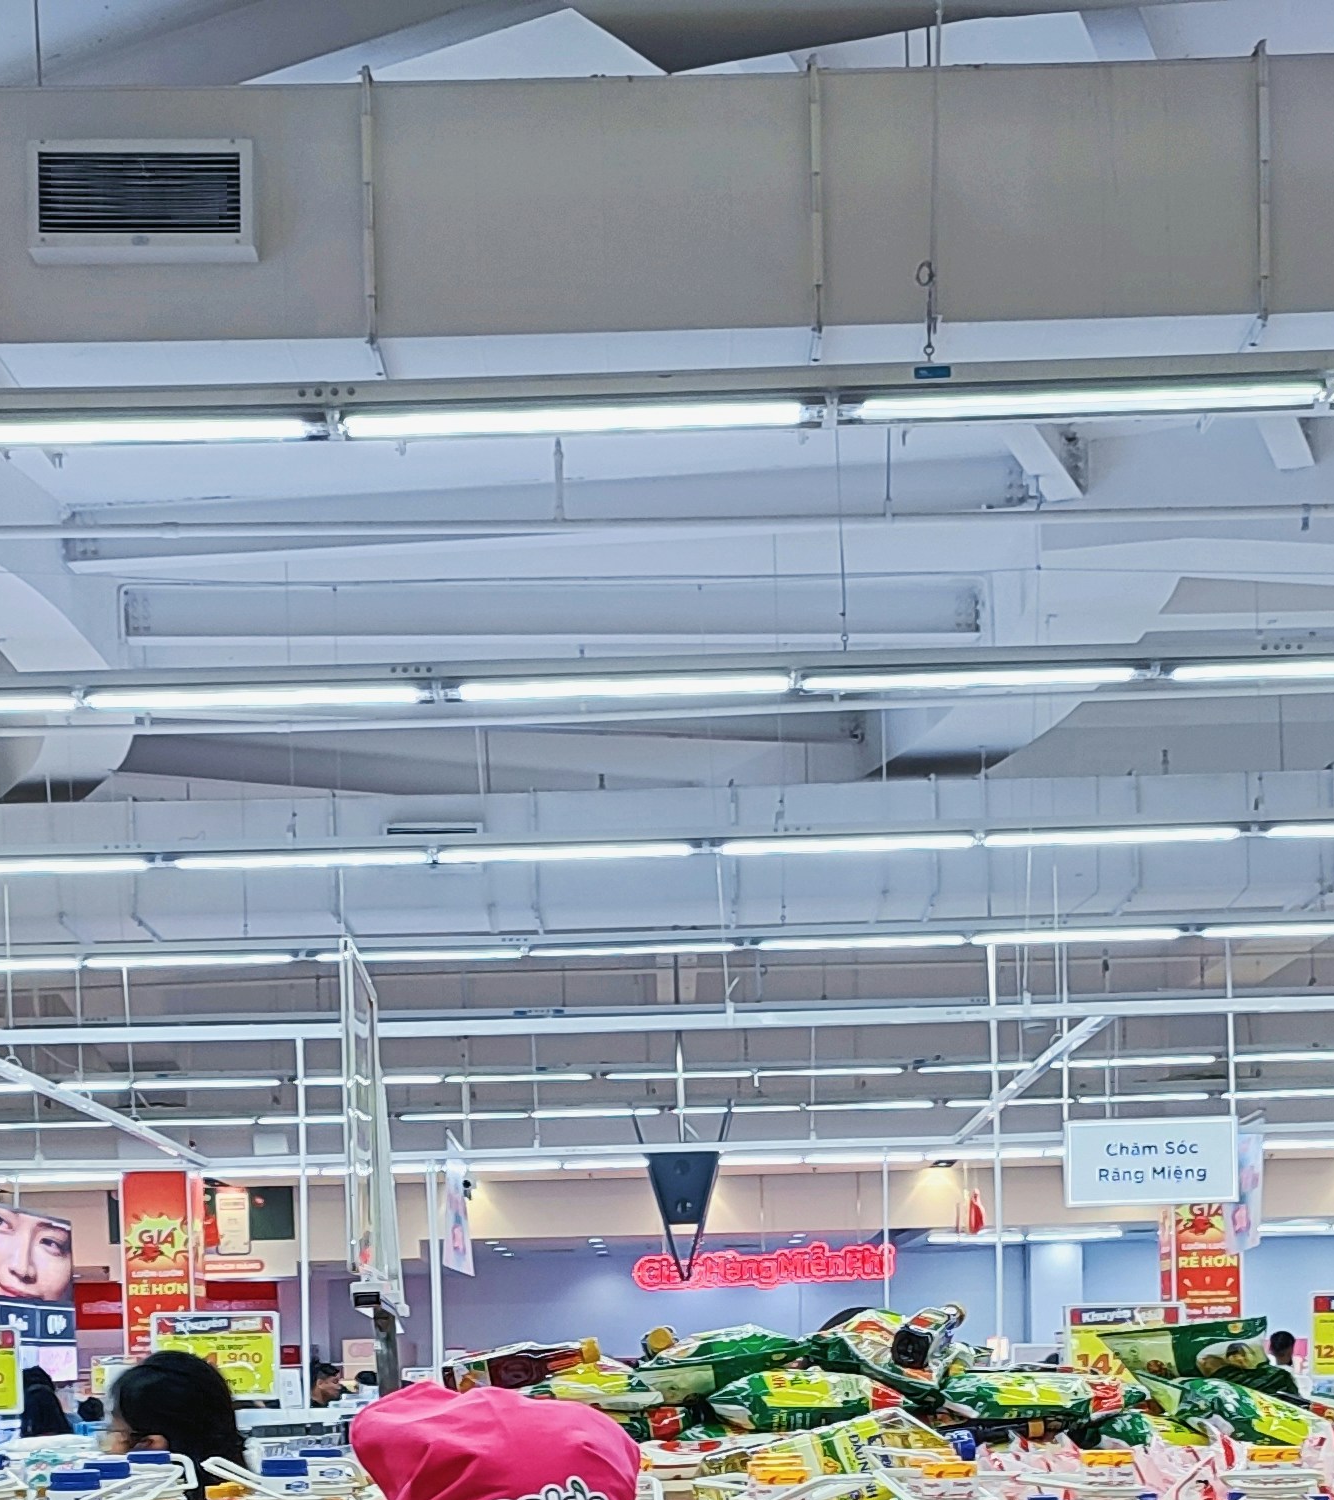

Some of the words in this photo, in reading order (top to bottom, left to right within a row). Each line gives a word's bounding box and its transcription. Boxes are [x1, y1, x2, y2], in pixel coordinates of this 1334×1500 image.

[1165, 1140, 1199, 1155] Sóc
[1152, 1166, 1208, 1183] Miệng
[138, 1226, 176, 1248] GIÁ
[1201, 1255, 1238, 1268] HƠN
[153, 1282, 188, 1296] HƠN
